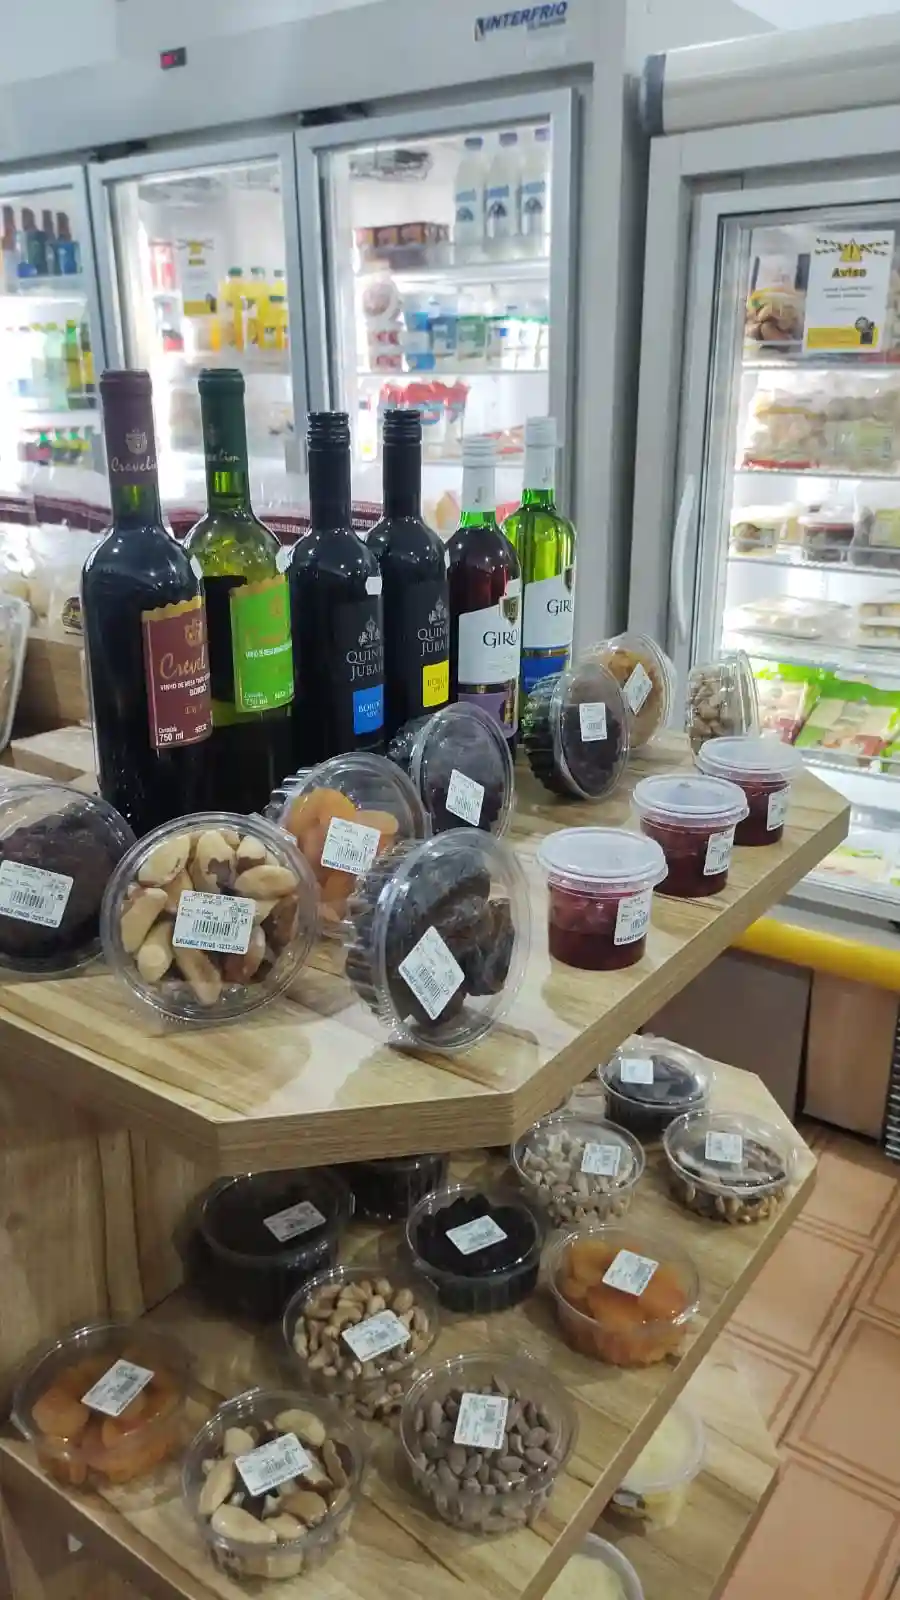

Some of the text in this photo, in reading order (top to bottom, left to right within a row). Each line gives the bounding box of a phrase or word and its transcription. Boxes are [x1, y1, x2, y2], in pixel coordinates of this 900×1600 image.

[485, 1, 568, 31] INTERFRIO
[831, 267, 867, 279] Aviso
[160, 683, 178, 692] VINHO
[177, 681, 185, 689] DE
[159, 730, 184, 742] 750 ml
